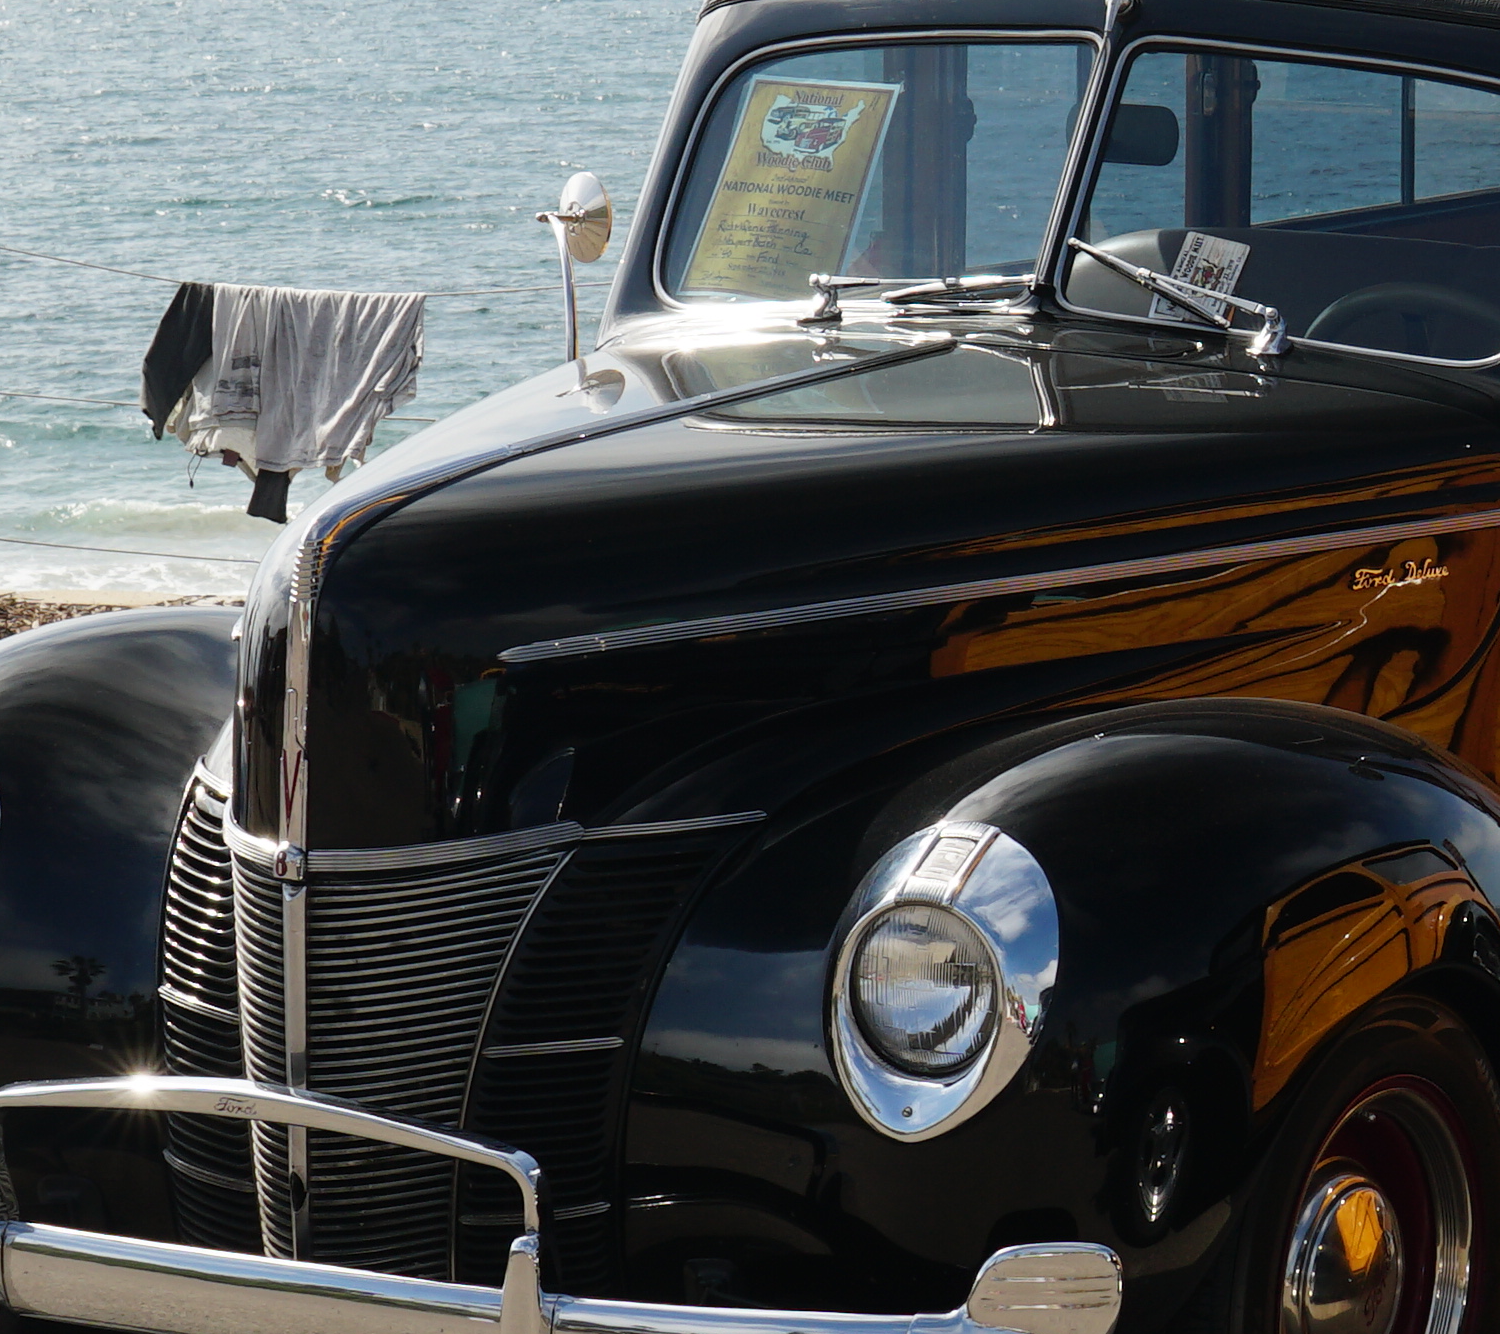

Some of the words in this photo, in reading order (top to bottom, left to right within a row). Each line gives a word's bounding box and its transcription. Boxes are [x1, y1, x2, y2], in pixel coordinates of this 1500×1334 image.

[795, 90, 844, 108] National
[756, 151, 800, 172] Woodie
[723, 180, 774, 194] NATIONAL
[776, 184, 822, 198] WOODIE
[823, 189, 855, 204] MEET
[747, 202, 806, 221] Wavecrest
[1352, 568, 1396, 590] Ford
[1403, 558, 1450, 581] Deluxe
[214, 1097, 257, 1116] Ford
